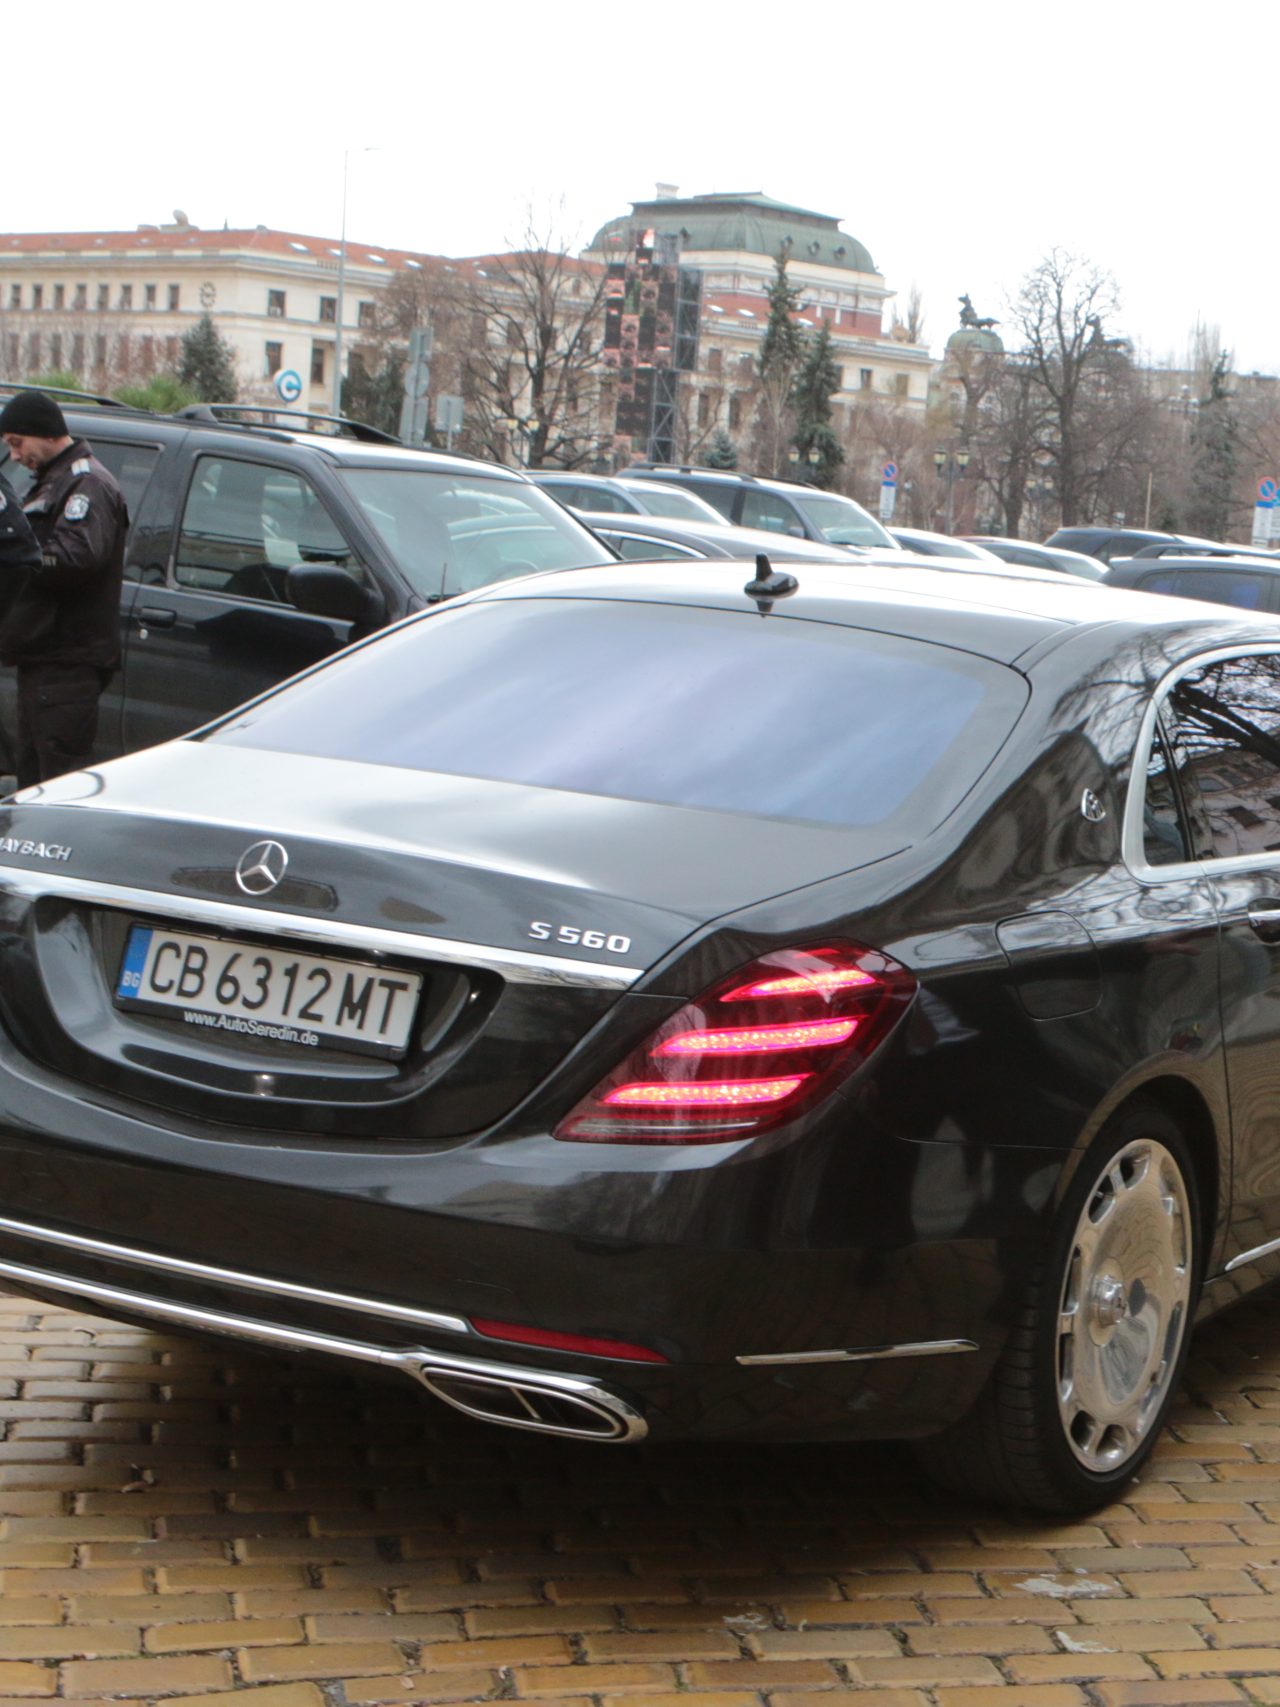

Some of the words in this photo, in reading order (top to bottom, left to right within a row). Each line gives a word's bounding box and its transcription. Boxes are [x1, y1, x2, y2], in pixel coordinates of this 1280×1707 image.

[528, 921, 552, 940] S
[557, 926, 631, 953] 560
[122, 970, 141, 987] BG
[183, 1010, 319, 1045] www.AutoSeredin.de
